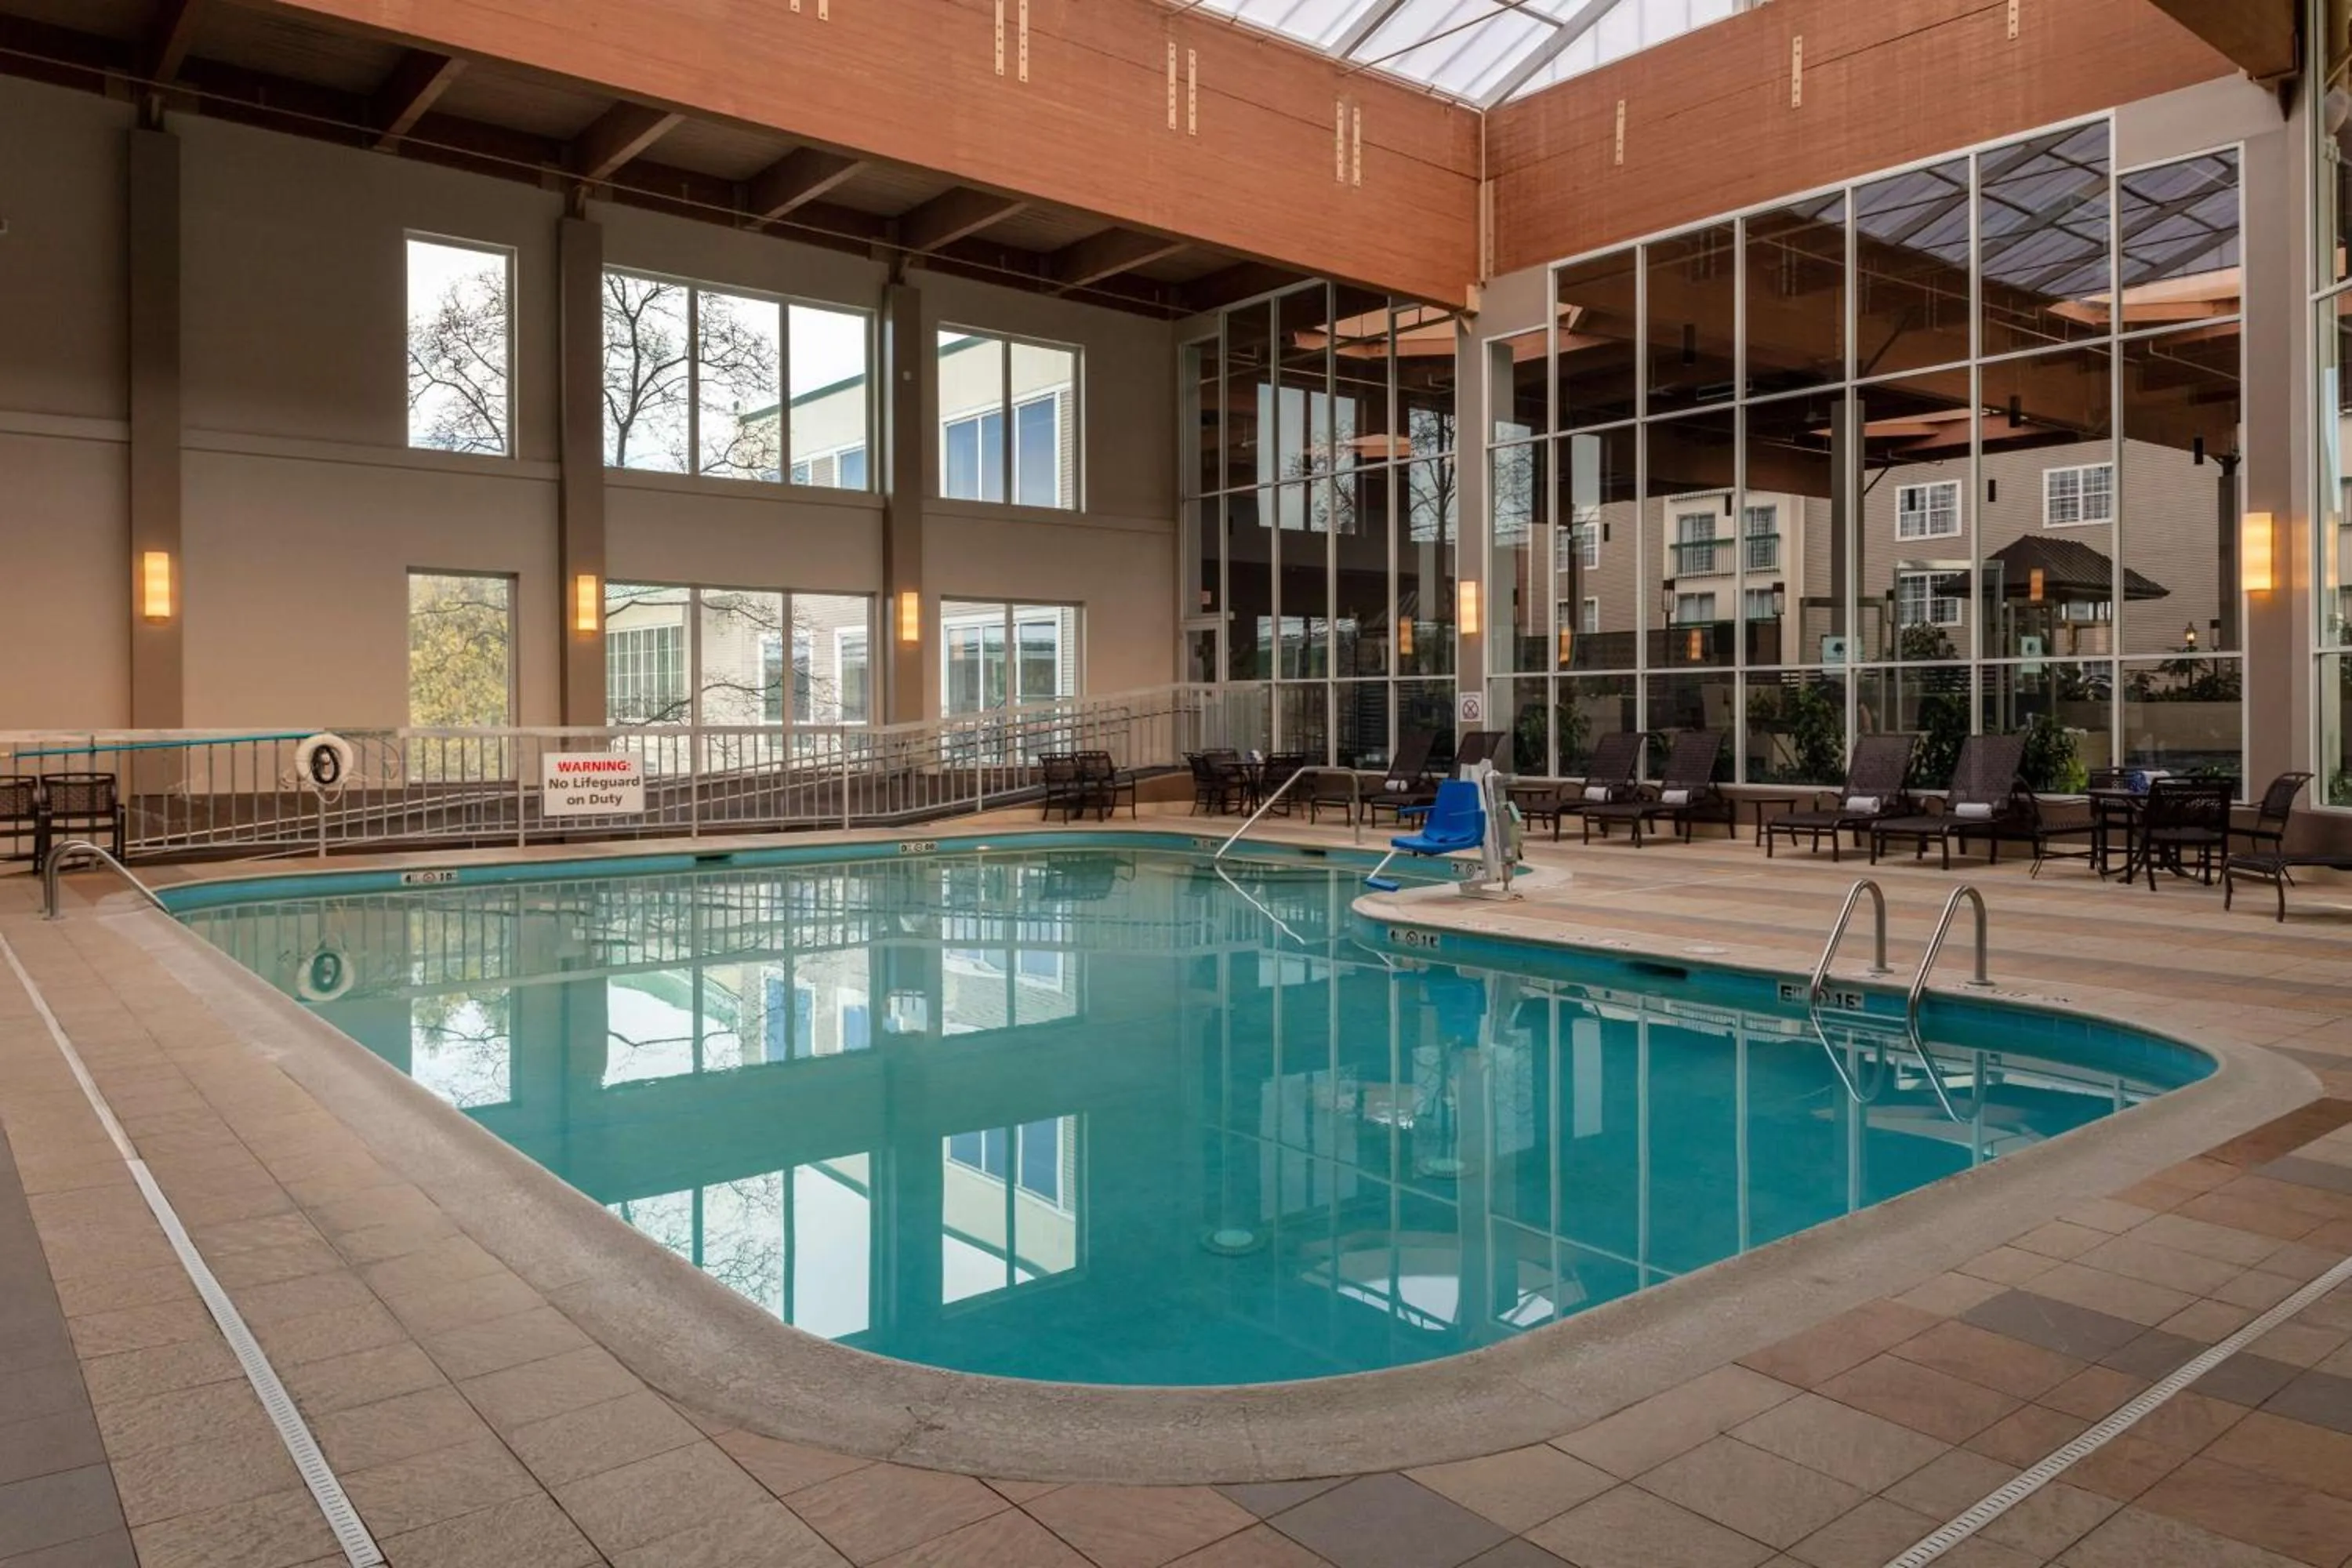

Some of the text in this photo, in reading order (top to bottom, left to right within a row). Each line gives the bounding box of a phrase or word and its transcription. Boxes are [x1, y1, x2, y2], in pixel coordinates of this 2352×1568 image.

[557, 760, 631, 772] WARNING:
[549, 775, 640, 790] No Lifeguard
[567, 793, 622, 806] on Duty
